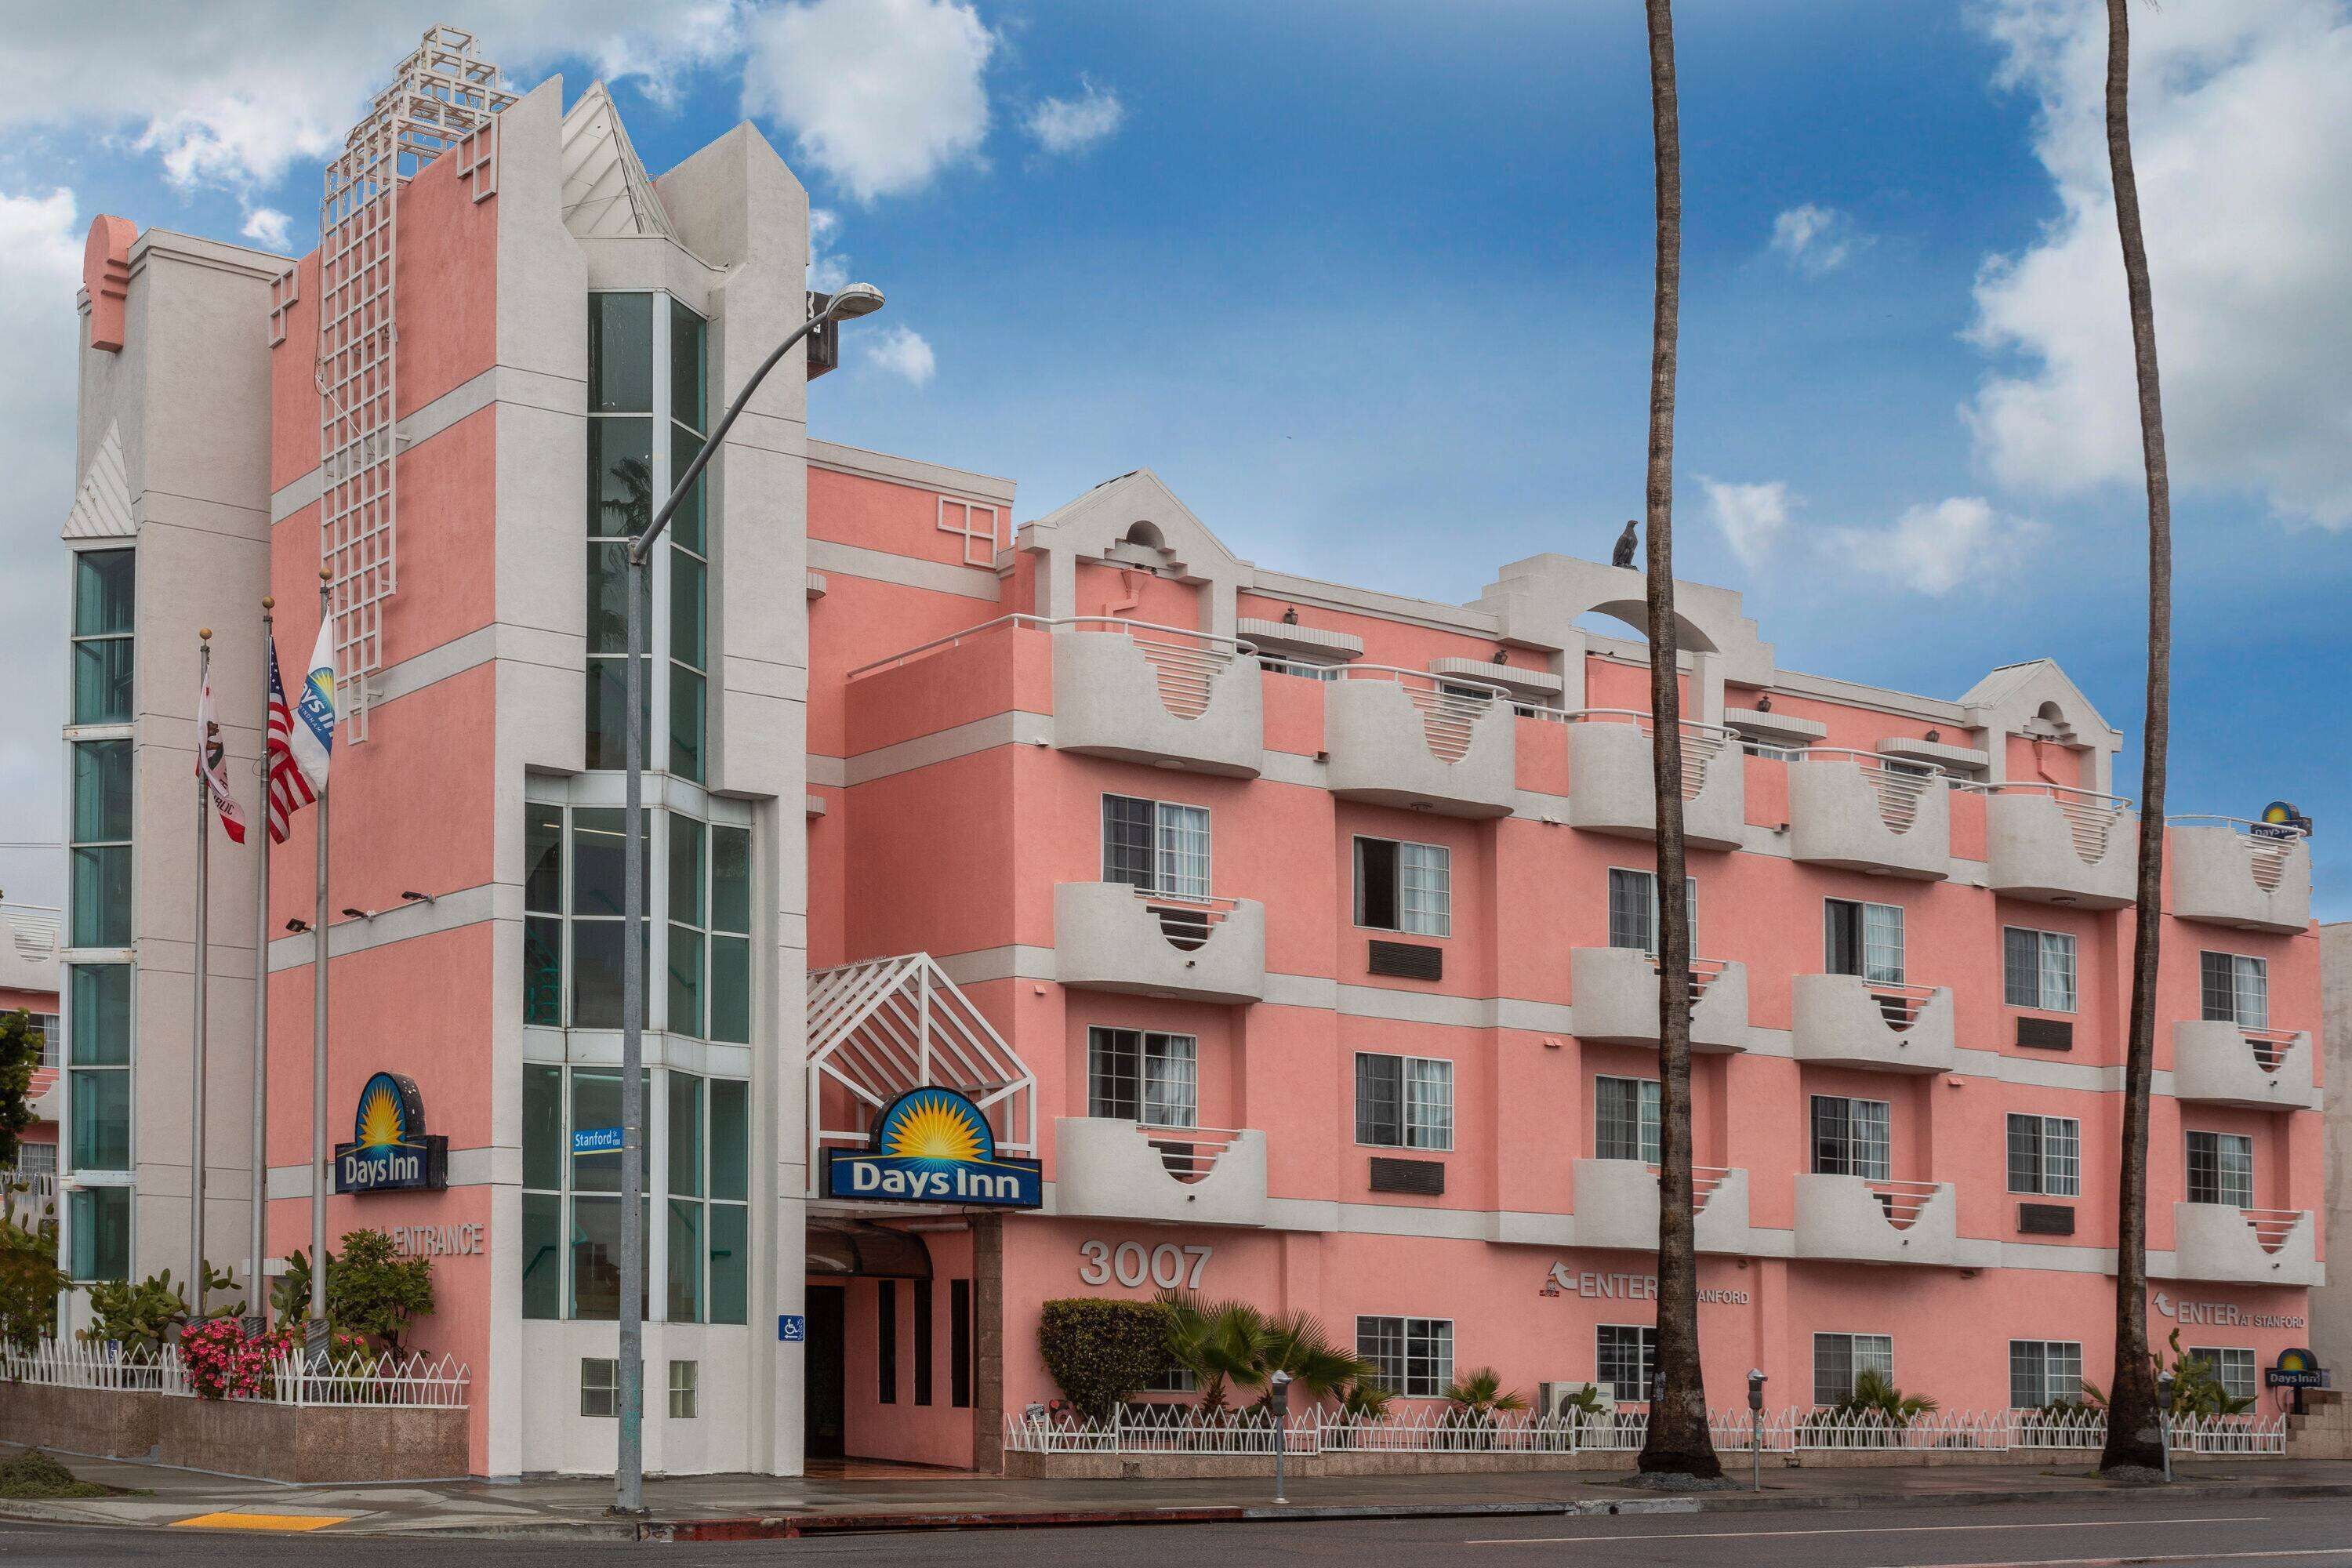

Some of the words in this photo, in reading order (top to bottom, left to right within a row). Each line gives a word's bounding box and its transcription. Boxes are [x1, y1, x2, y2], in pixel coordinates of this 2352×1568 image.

[575, 1130, 612, 1147] Stanford
[346, 1156, 387, 1187] Days
[390, 1152, 419, 1181] Inn
[853, 1162, 950, 1198] Days
[957, 1168, 1019, 1199] Inn
[394, 1223, 485, 1256] ENTRANCE
[1080, 1240, 1213, 1289] 3007
[1580, 1272, 1658, 1299] ENTER
[1695, 1288, 1750, 1305] ANFORD
[2178, 1301, 2239, 1326] ENTER
[2239, 1315, 2252, 1326] AT
[2254, 1316, 2306, 1328] STANFORD
[2270, 1374, 2297, 1382] Days
